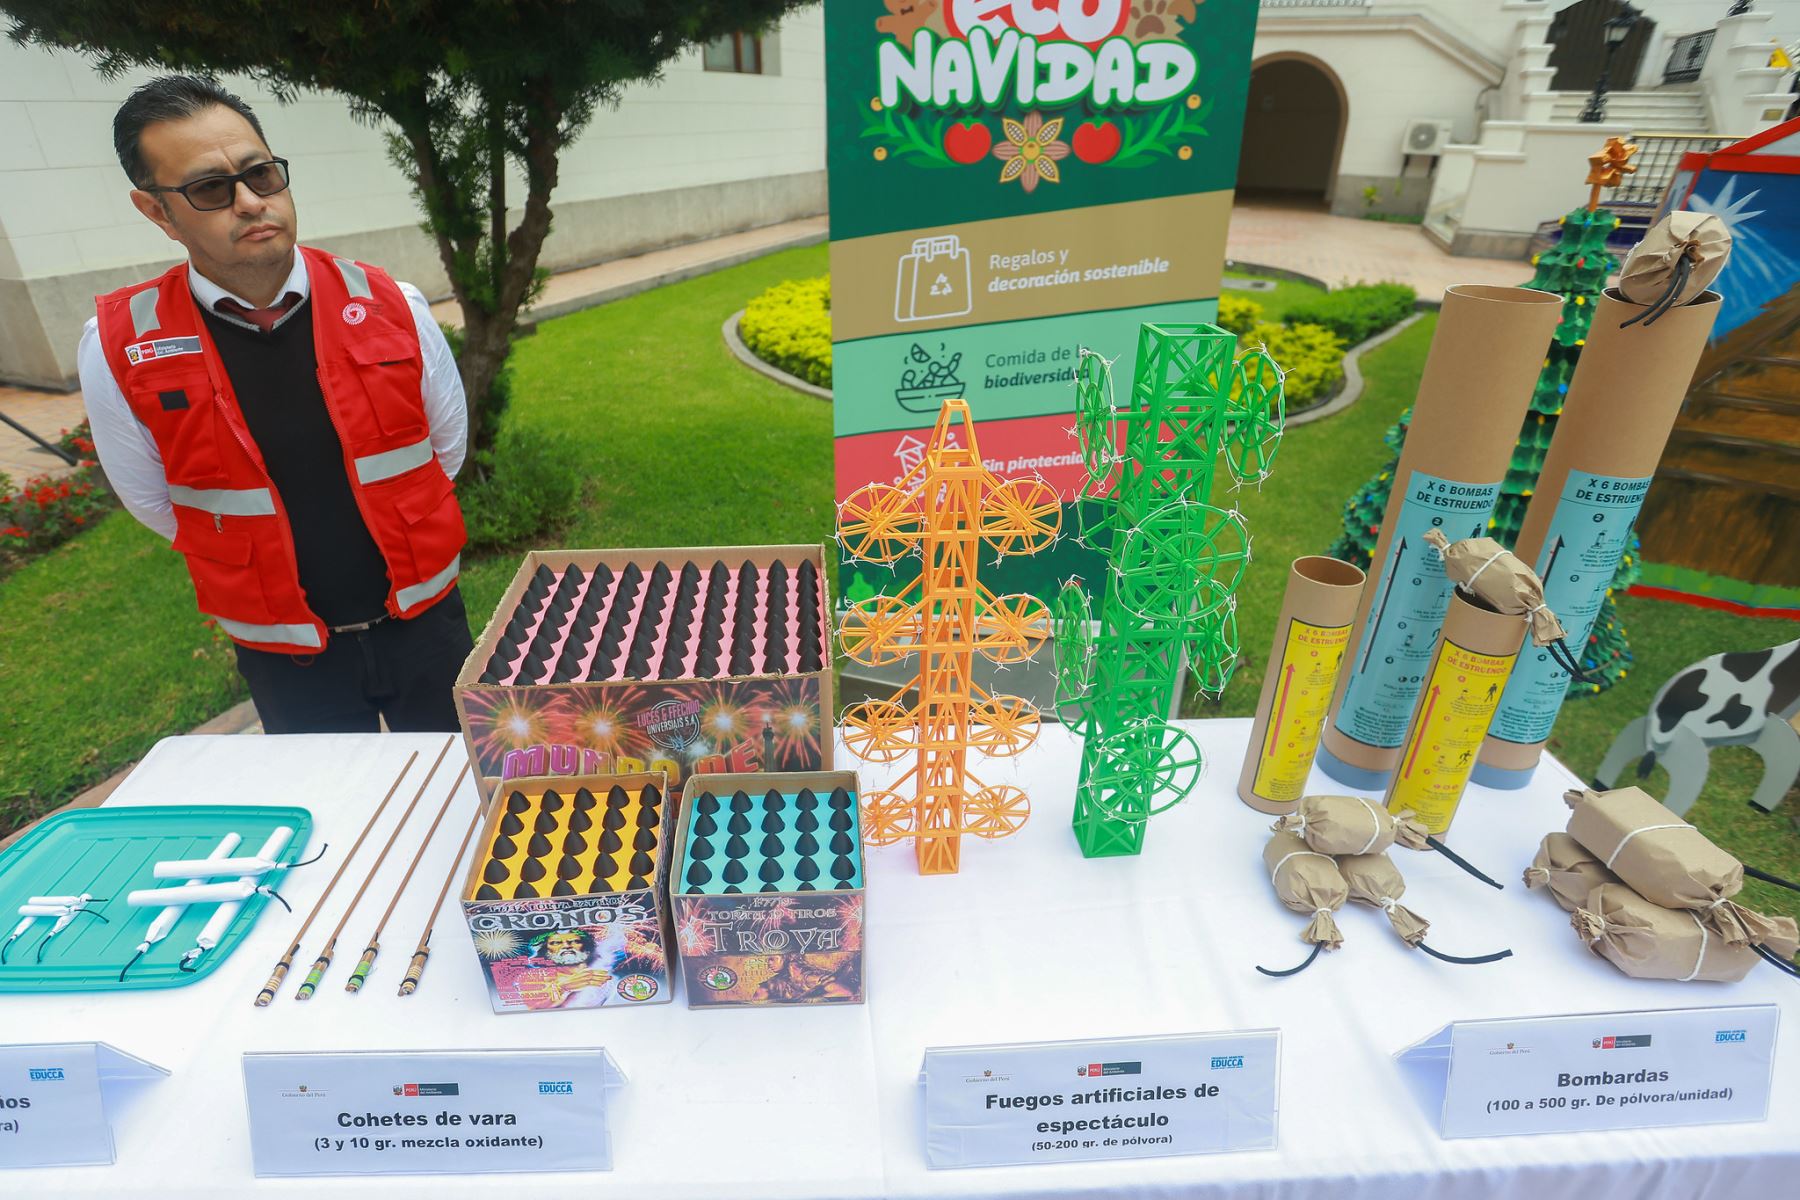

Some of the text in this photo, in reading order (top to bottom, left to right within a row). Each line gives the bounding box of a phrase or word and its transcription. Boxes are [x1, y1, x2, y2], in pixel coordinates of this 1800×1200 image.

[878, 27, 1197, 107] NAVIDAD
[989, 249, 1069, 271] Regalos y
[987, 257, 1169, 293] decoración sostenible
[985, 349, 1046, 368] Comida
[1051, 345, 1071, 361] de
[981, 459, 1004, 472] Sin
[1427, 481, 1493, 497] X 6 BOMBAS
[1588, 479, 1598, 488] X
[1601, 481, 1609, 489] 6
[1416, 491, 1431, 503] DE
[1576, 489, 1593, 500] DE
[469, 906, 647, 931] CRONOS
[1211, 1059, 1243, 1067] EDUCCA
[30, 1071, 64, 1079] EDUCCA
[1557, 1069, 1669, 1088] Bombardas
[538, 1084, 573, 1093] EDUCCA
[985, 1083, 1220, 1111] Fuegos artificiales de
[1486, 1088, 1733, 1114] (100 a 500 gr. De pólvora/unidad)
[337, 1111, 517, 1128] Cohetes de vara
[1036, 1113, 1169, 1135] espectáculo
[314, 1135, 544, 1151] (3 y 10 gr. mezcla oxidante)
[1031, 1134, 1173, 1152] (50-200 gr. de pólvora)
